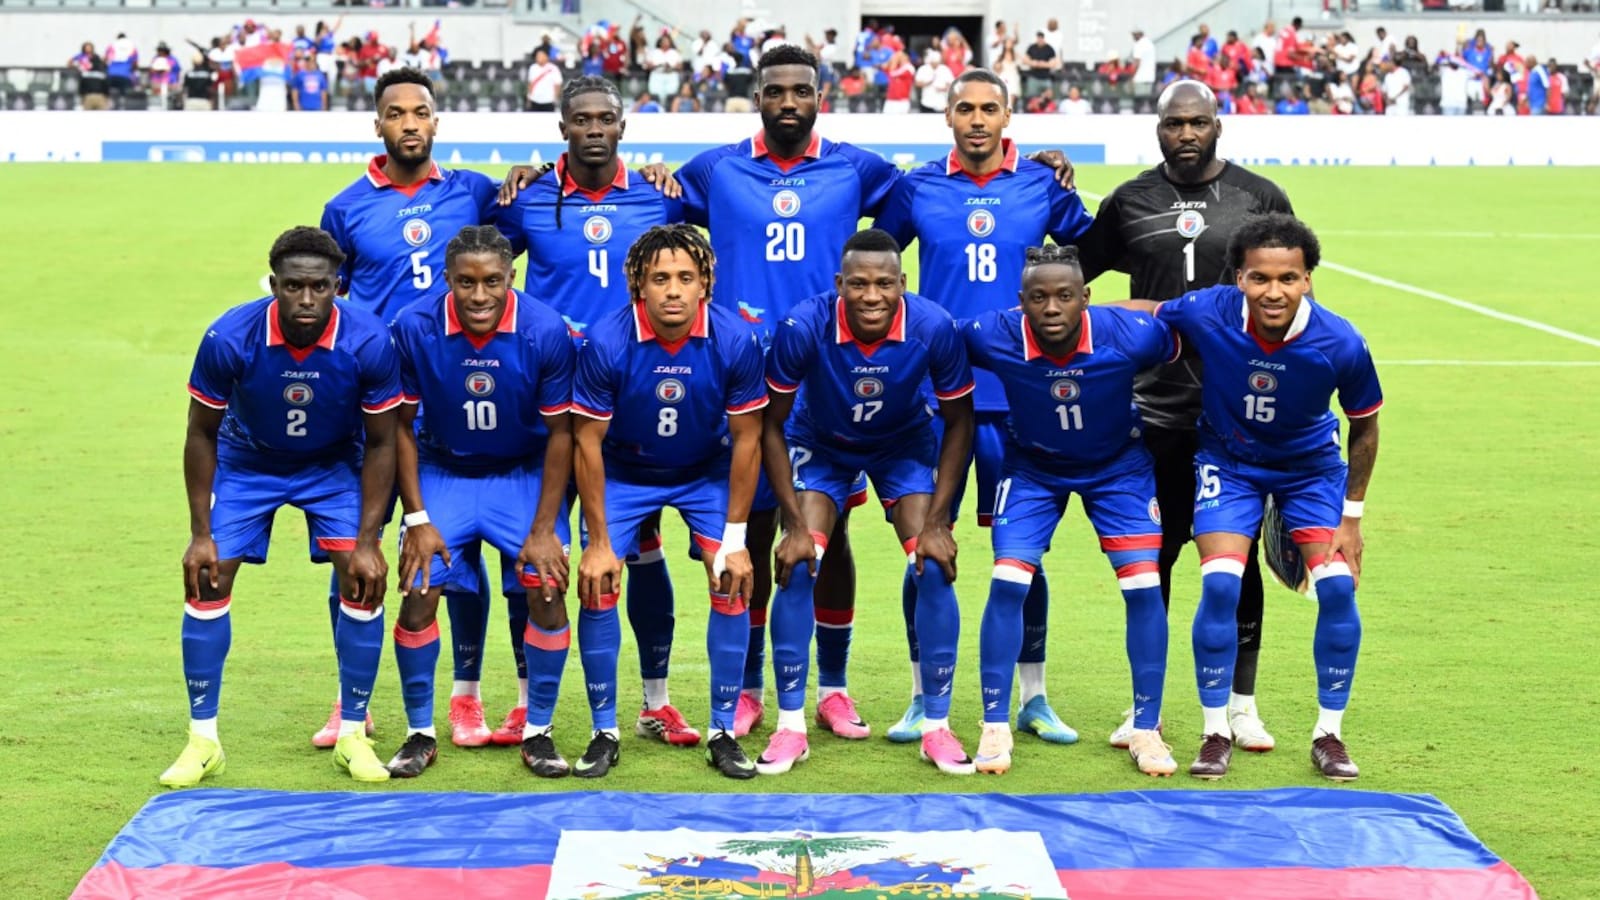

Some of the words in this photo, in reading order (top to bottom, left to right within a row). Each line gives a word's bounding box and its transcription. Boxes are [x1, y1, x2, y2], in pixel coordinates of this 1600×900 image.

[769, 178, 805, 187] SAETA
[964, 198, 1001, 206] SAETA
[1170, 201, 1207, 209] SAETA
[396, 204, 432, 218] SAETA
[579, 205, 617, 213] SAETA
[765, 222, 805, 262] 20
[964, 243, 997, 283] 18
[1183, 242, 1195, 282] 1
[410, 251, 433, 290] 5
[588, 249, 608, 288] 4
[461, 359, 500, 368] SAETA
[1248, 359, 1286, 371] SAETA
[281, 370, 320, 379] SAETA
[653, 366, 692, 375] SAETA
[850, 366, 889, 374] SAETA
[1045, 368, 1084, 377] SAETA
[851, 400, 883, 423] 17
[1243, 394, 1276, 423] 15
[462, 400, 497, 431] 10
[1055, 404, 1083, 431] 11
[286, 408, 307, 437] 2
[657, 407, 678, 437] 8
[784, 664, 803, 673] FHF
[1203, 666, 1225, 675] FHF
[1328, 667, 1350, 675] FHF
[188, 679, 209, 689] FHF
[588, 683, 607, 692] FHF
[353, 686, 370, 695] FHF
[984, 687, 1000, 695] FHF
